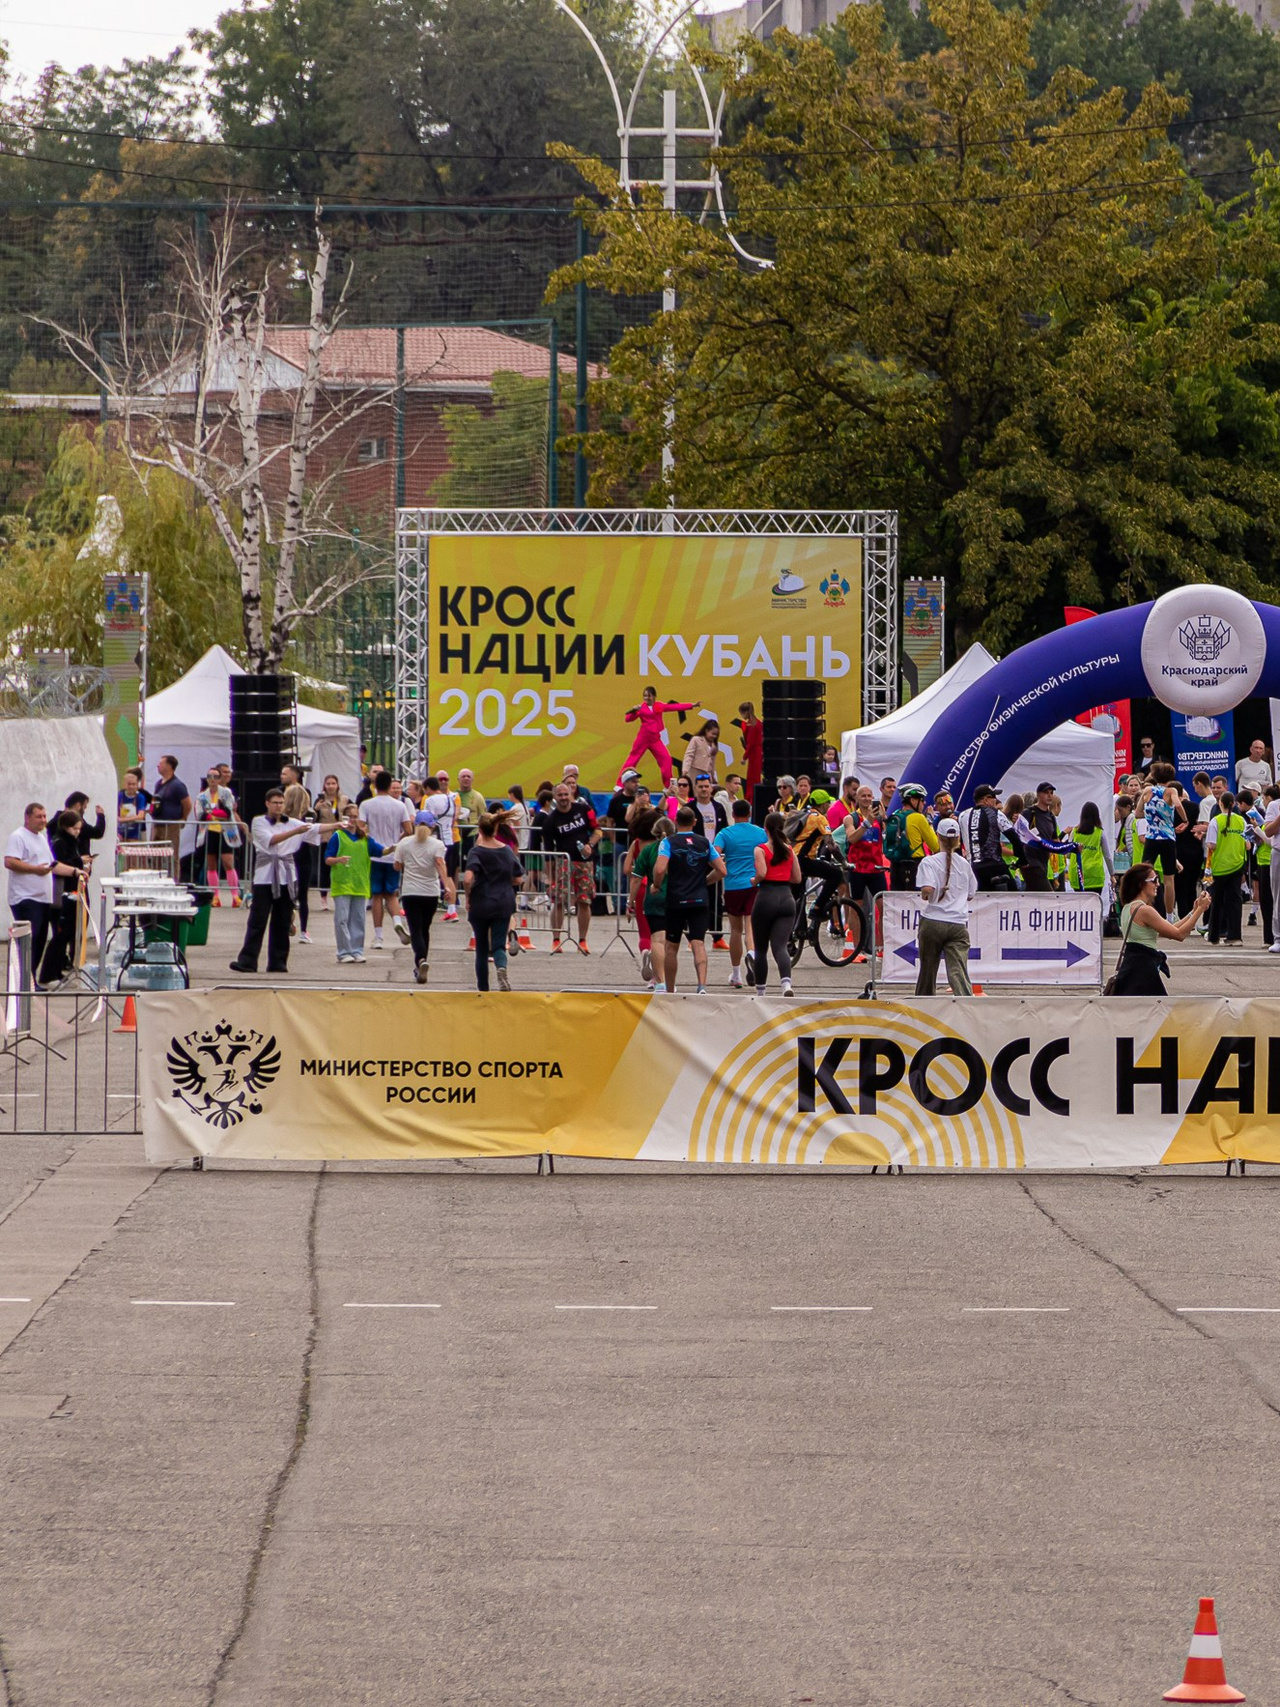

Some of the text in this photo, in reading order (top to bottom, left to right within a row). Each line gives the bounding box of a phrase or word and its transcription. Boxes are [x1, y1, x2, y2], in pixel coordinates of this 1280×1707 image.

[439, 585, 576, 627] КРОСС
[439, 634, 851, 683] НАЦИИ КУБАНЬ
[1161, 664, 1248, 678] Краснодарский
[1191, 677, 1219, 688] край
[989, 676, 1059, 732] ФИЗИЧЕСКОЙ
[1058, 653, 1120, 684] КУЛЬТУРЫ
[439, 689, 577, 737] 2025
[557, 817, 586, 834] TEAM
[999, 910, 1021, 932] НА
[1029, 908, 1094, 932] ФИНИШ
[300, 1059, 564, 1079] МИНИСТЕРСТВО СПОРТА
[797, 1036, 1070, 1117] КРОСС
[386, 1086, 476, 1104] РОССИИ
